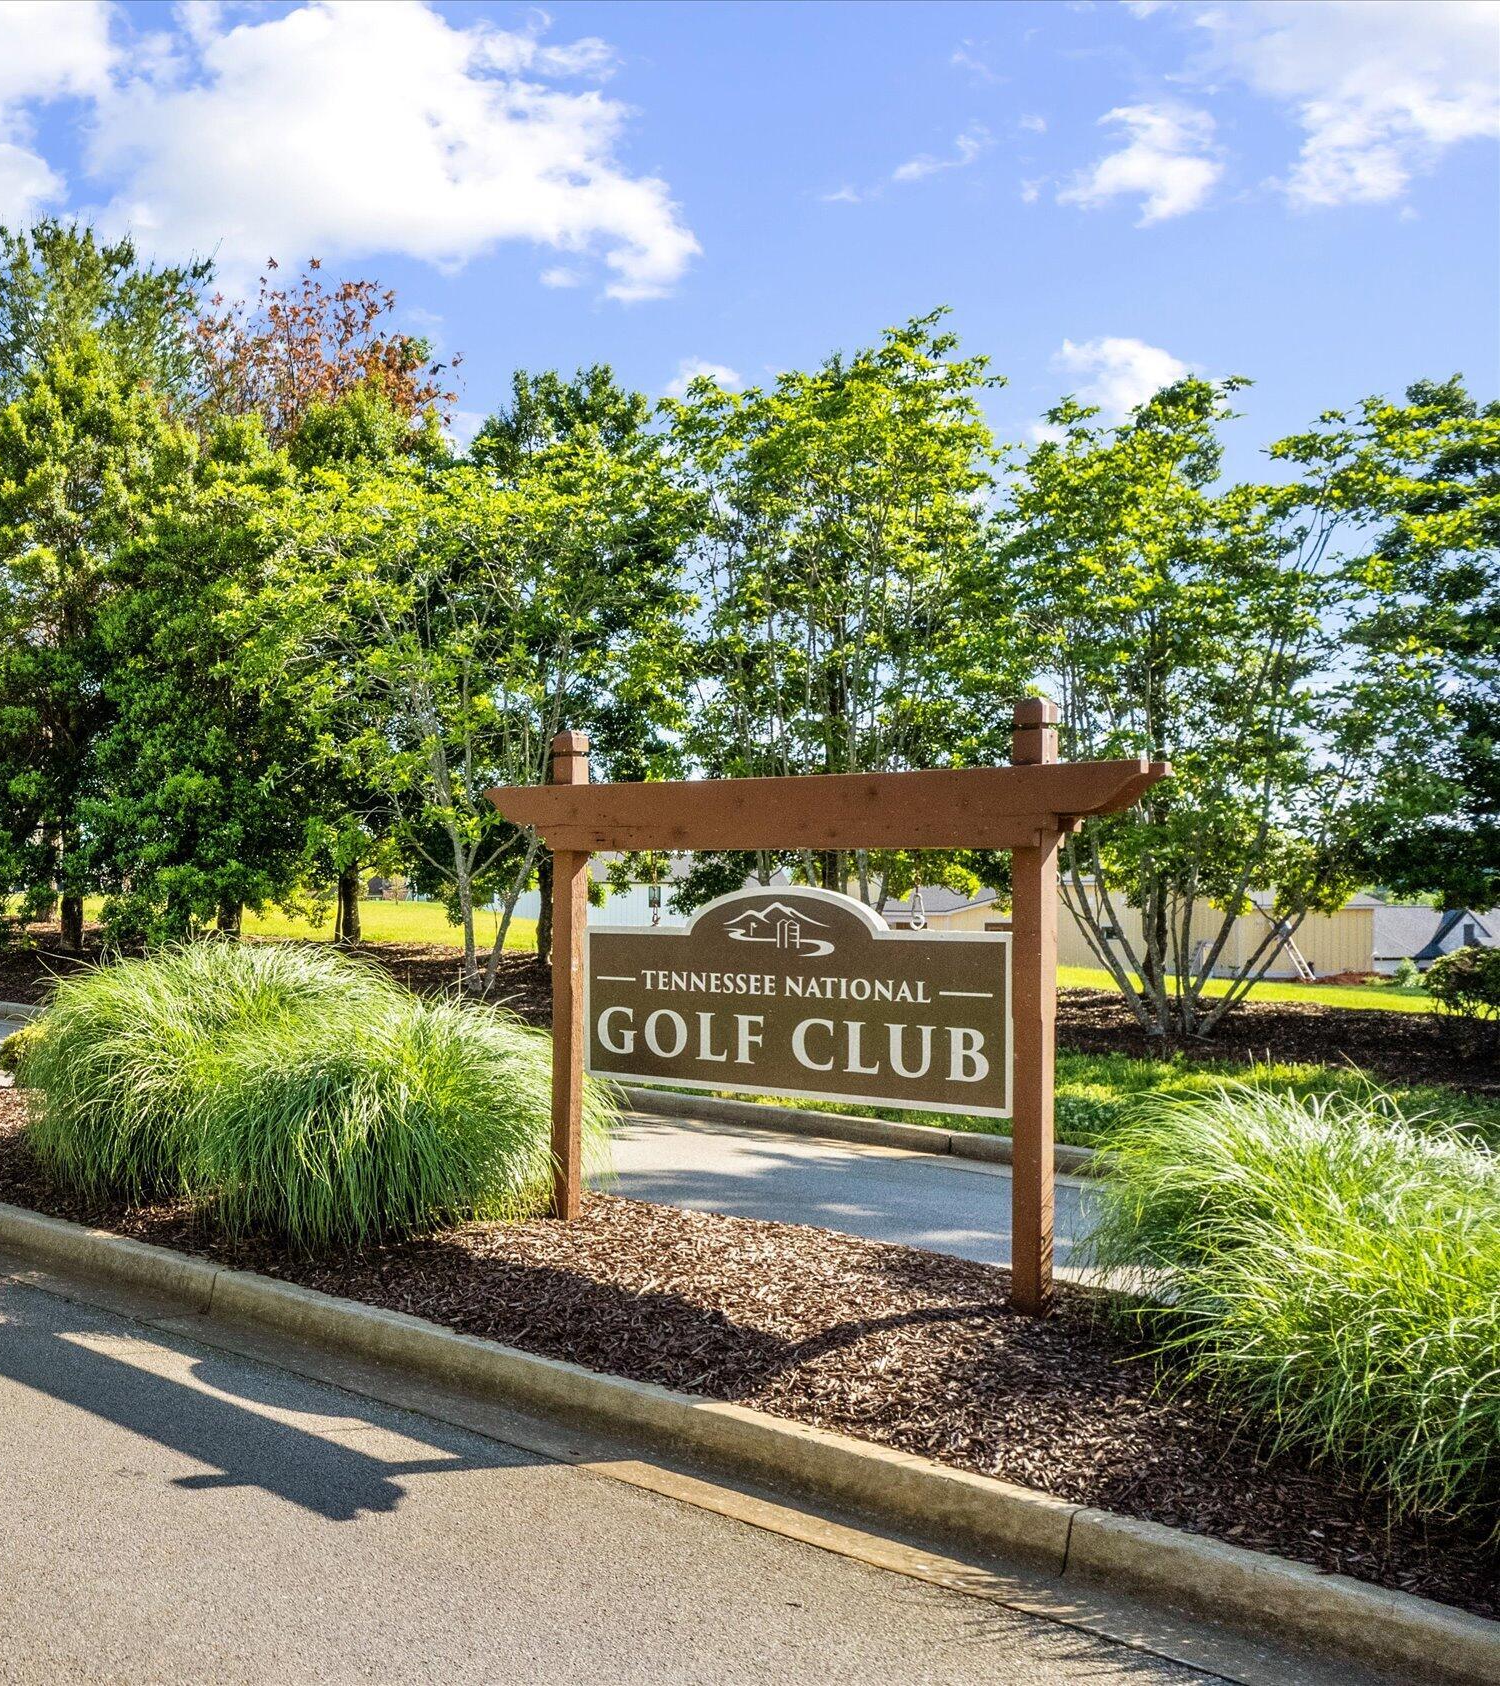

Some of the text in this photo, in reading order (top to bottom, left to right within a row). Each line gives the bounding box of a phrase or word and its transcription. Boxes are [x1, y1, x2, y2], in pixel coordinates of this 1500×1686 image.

[641, 969, 931, 1004] TENNESSEE NATIONAL
[597, 1006, 990, 1083] GOLF CLUB
